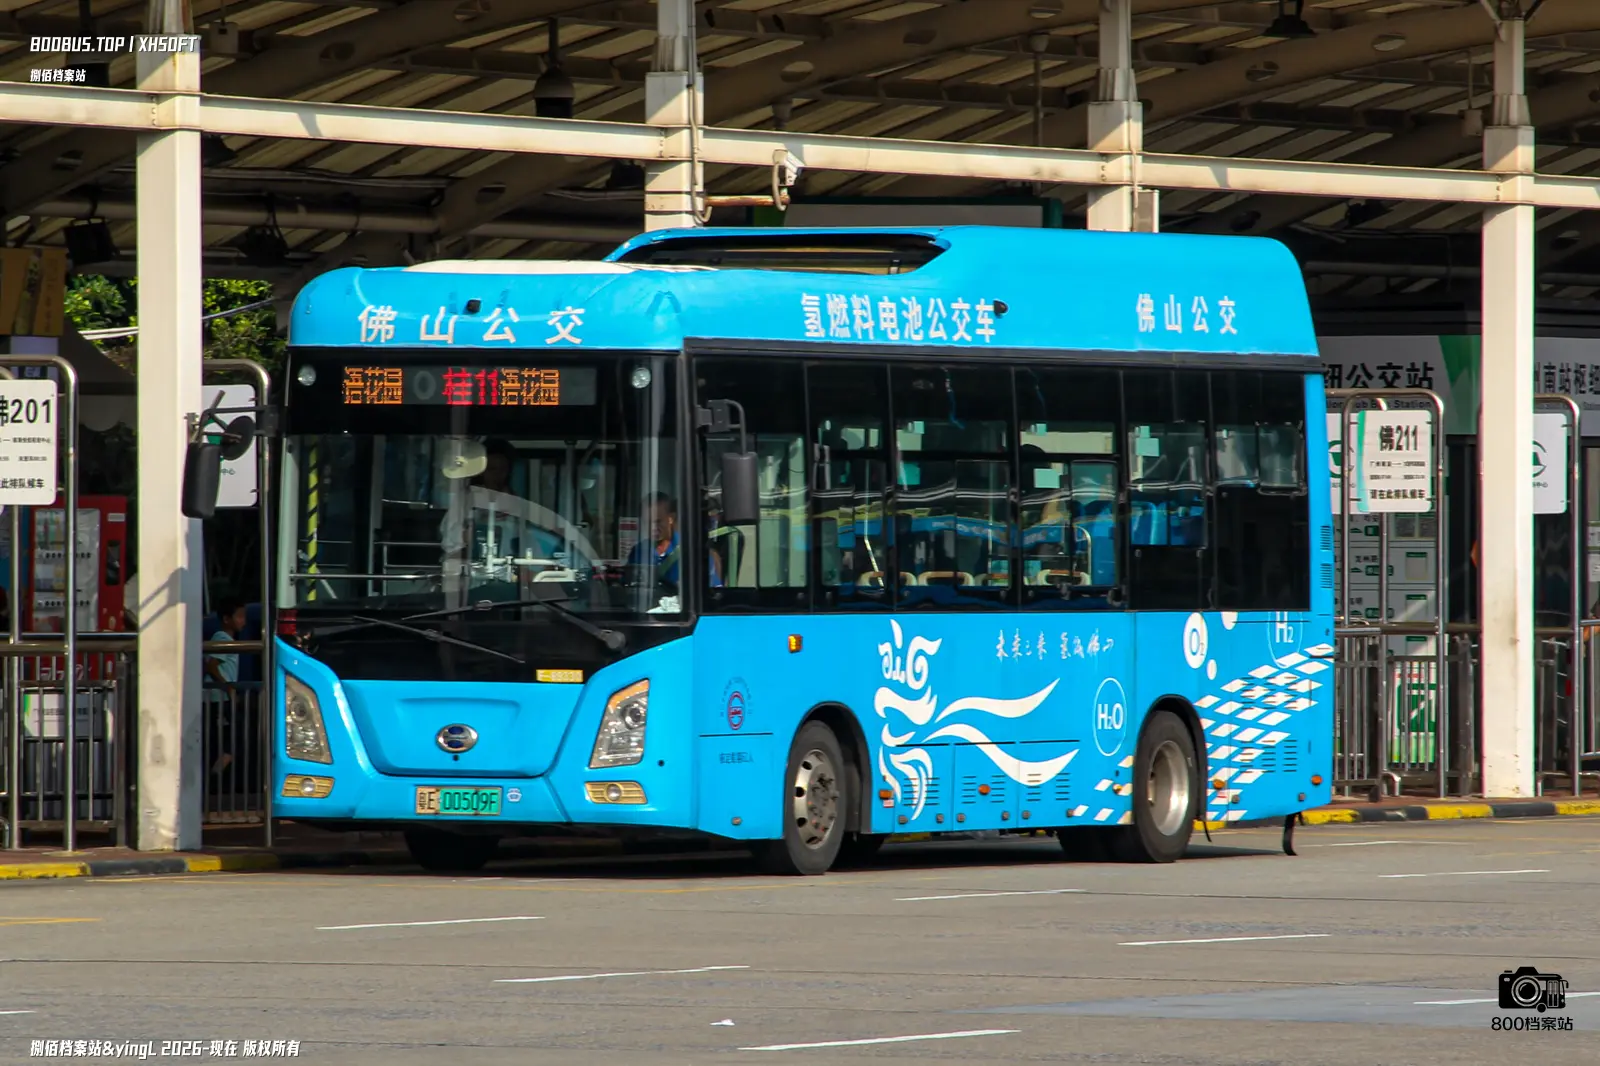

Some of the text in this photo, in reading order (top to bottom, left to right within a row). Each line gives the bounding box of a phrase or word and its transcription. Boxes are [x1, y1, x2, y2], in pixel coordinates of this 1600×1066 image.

[357, 304, 586, 345] 佛山公交
[801, 292, 996, 343] 氢燃料电池公交车
[1136, 293, 1238, 335] 佛山公交
[1394, 400, 1432, 409] Station
[1379, 425, 1418, 451] 佛211
[1369, 489, 1426, 500] 请在此排队候车
[1097, 702, 1124, 730] H2O
